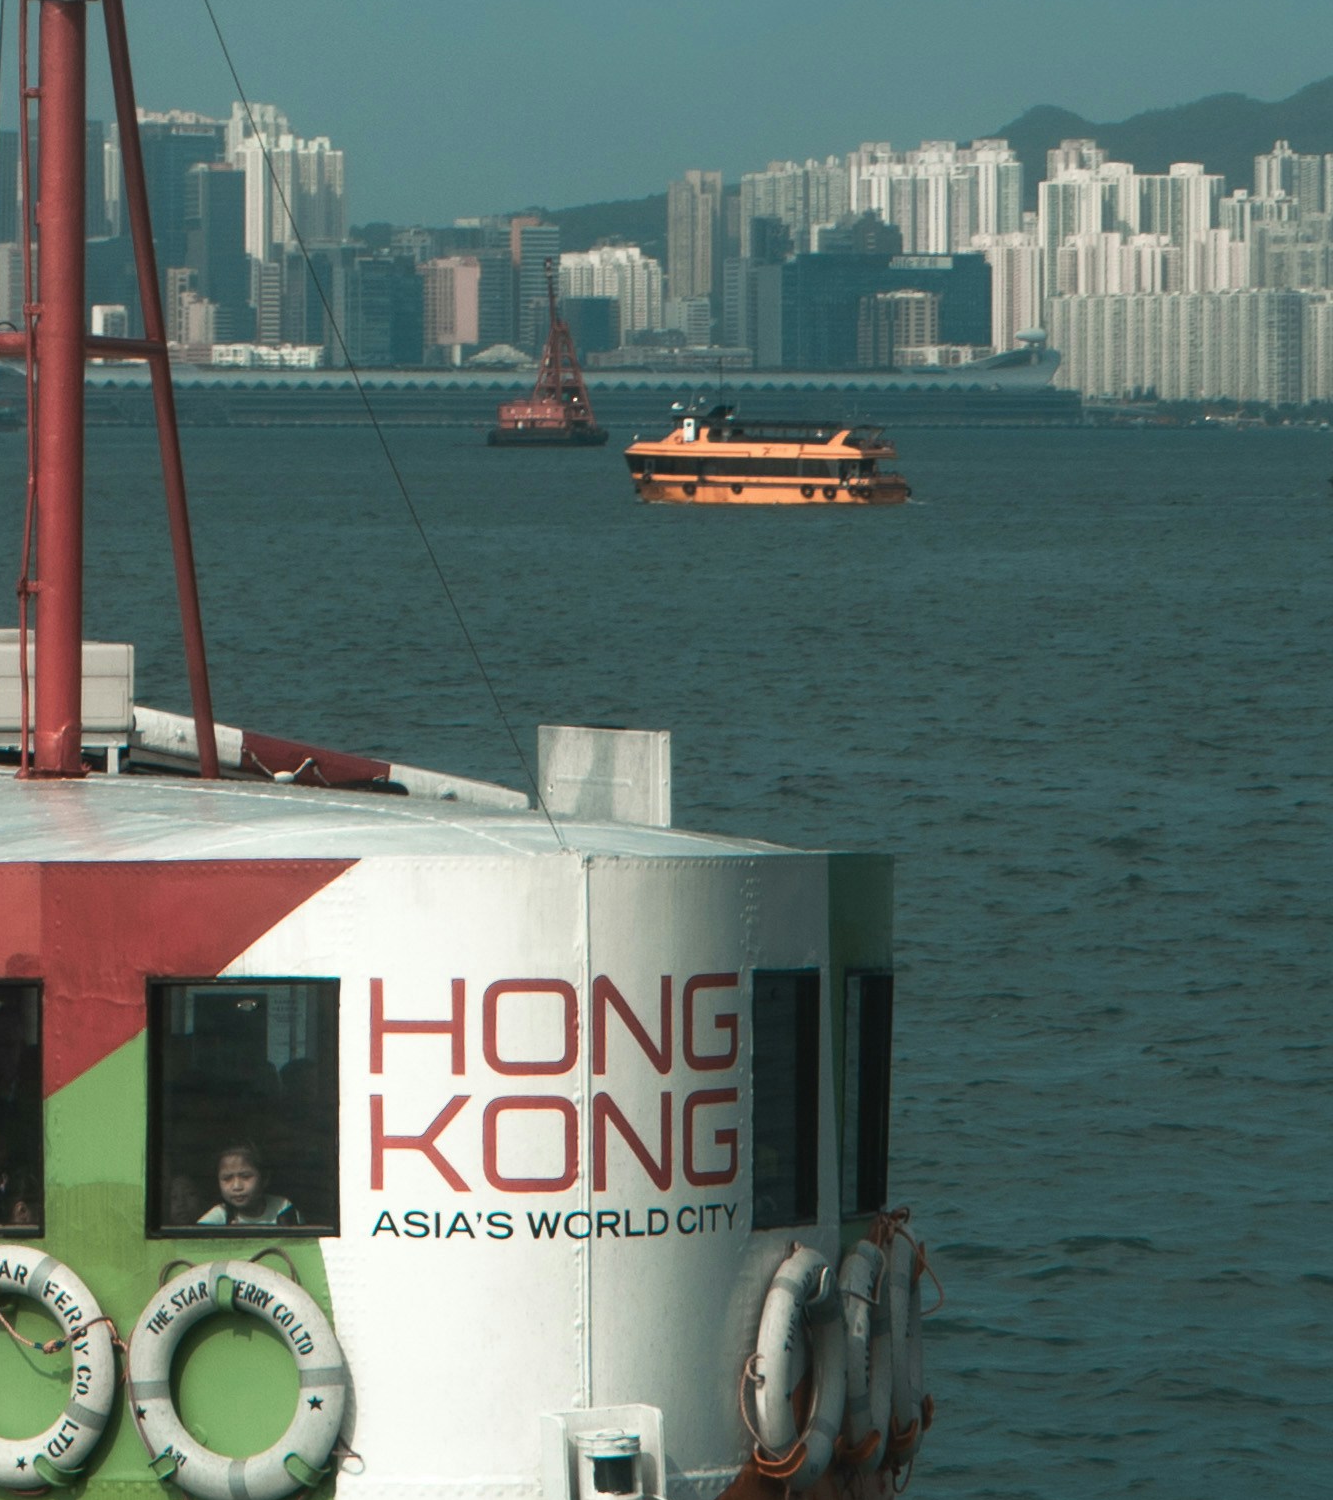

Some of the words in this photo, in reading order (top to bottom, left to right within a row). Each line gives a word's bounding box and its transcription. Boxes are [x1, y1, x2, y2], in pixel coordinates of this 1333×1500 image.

[369, 971, 739, 1076] HONG
[369, 1086, 739, 1194] KONG
[371, 1208, 514, 1240] ASIA'S
[526, 1206, 670, 1240] WORLD
[675, 1202, 739, 1235] CITY
[146, 1303, 175, 1336] THE
[169, 1280, 210, 1313] STAR
[231, 1279, 275, 1310] ERRY
[288, 1322, 315, 1356] LTD
[46, 1418, 80, 1459] LTD
